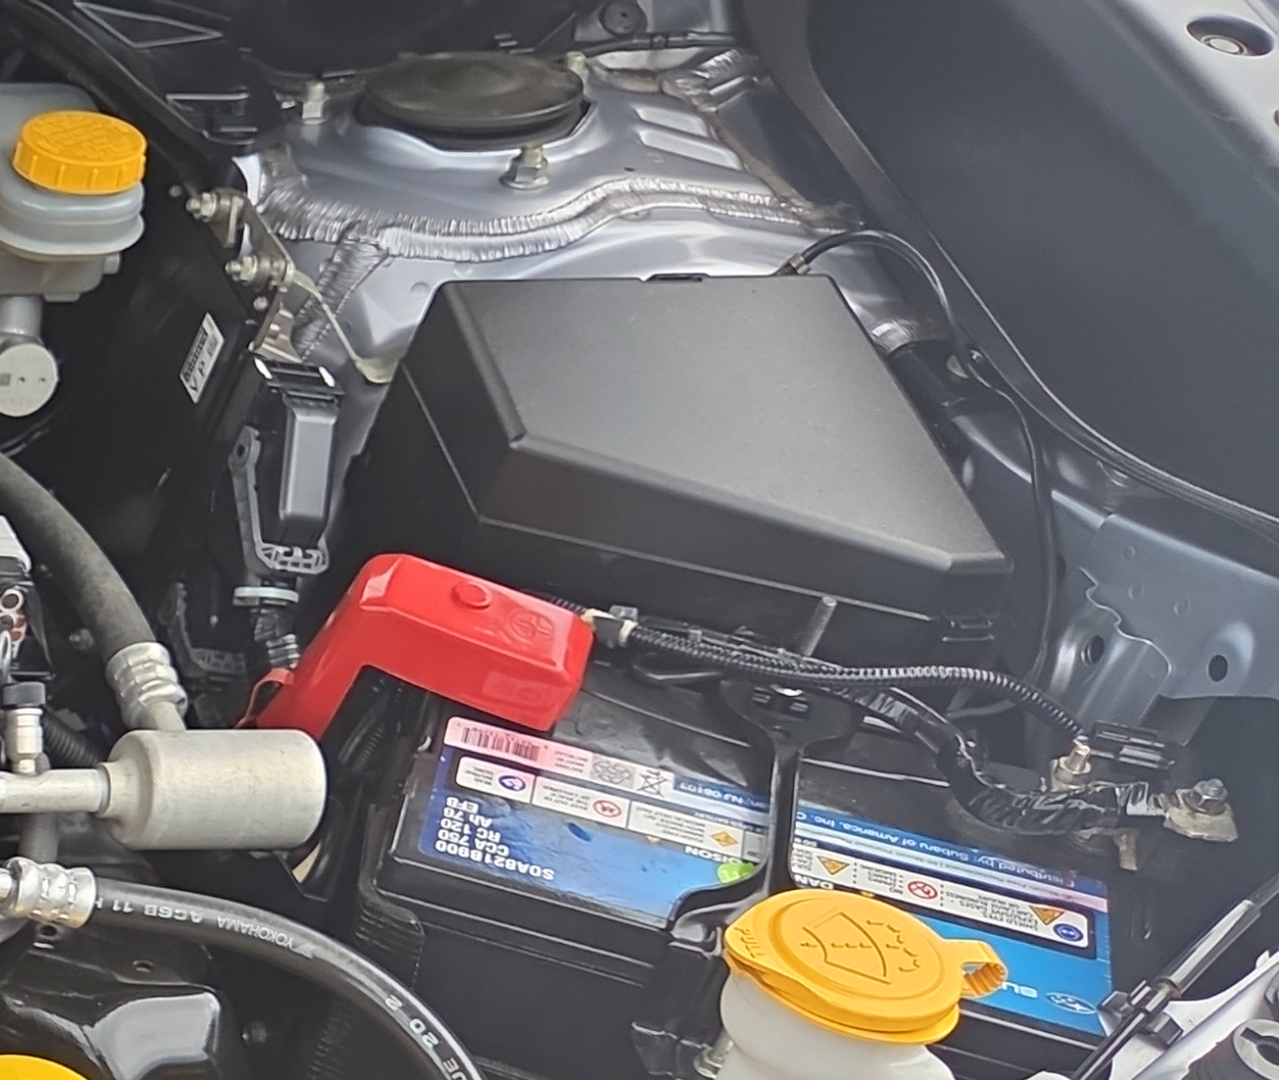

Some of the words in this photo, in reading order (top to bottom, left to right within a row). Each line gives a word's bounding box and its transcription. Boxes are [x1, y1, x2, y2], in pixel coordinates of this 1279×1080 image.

[444, 795, 480, 813] EFB
[438, 817, 473, 835] 120
[467, 813, 493, 828] Ah
[436, 828, 470, 846] 750
[474, 826, 501, 843] RC
[900, 836, 916, 848] of
[472, 837, 510, 857] CCA
[918, 840, 970, 861] Subaru
[111, 898, 134, 914] 11
[215, 915, 294, 948] YOKOHAMA
[408, 1018, 439, 1049] 20
